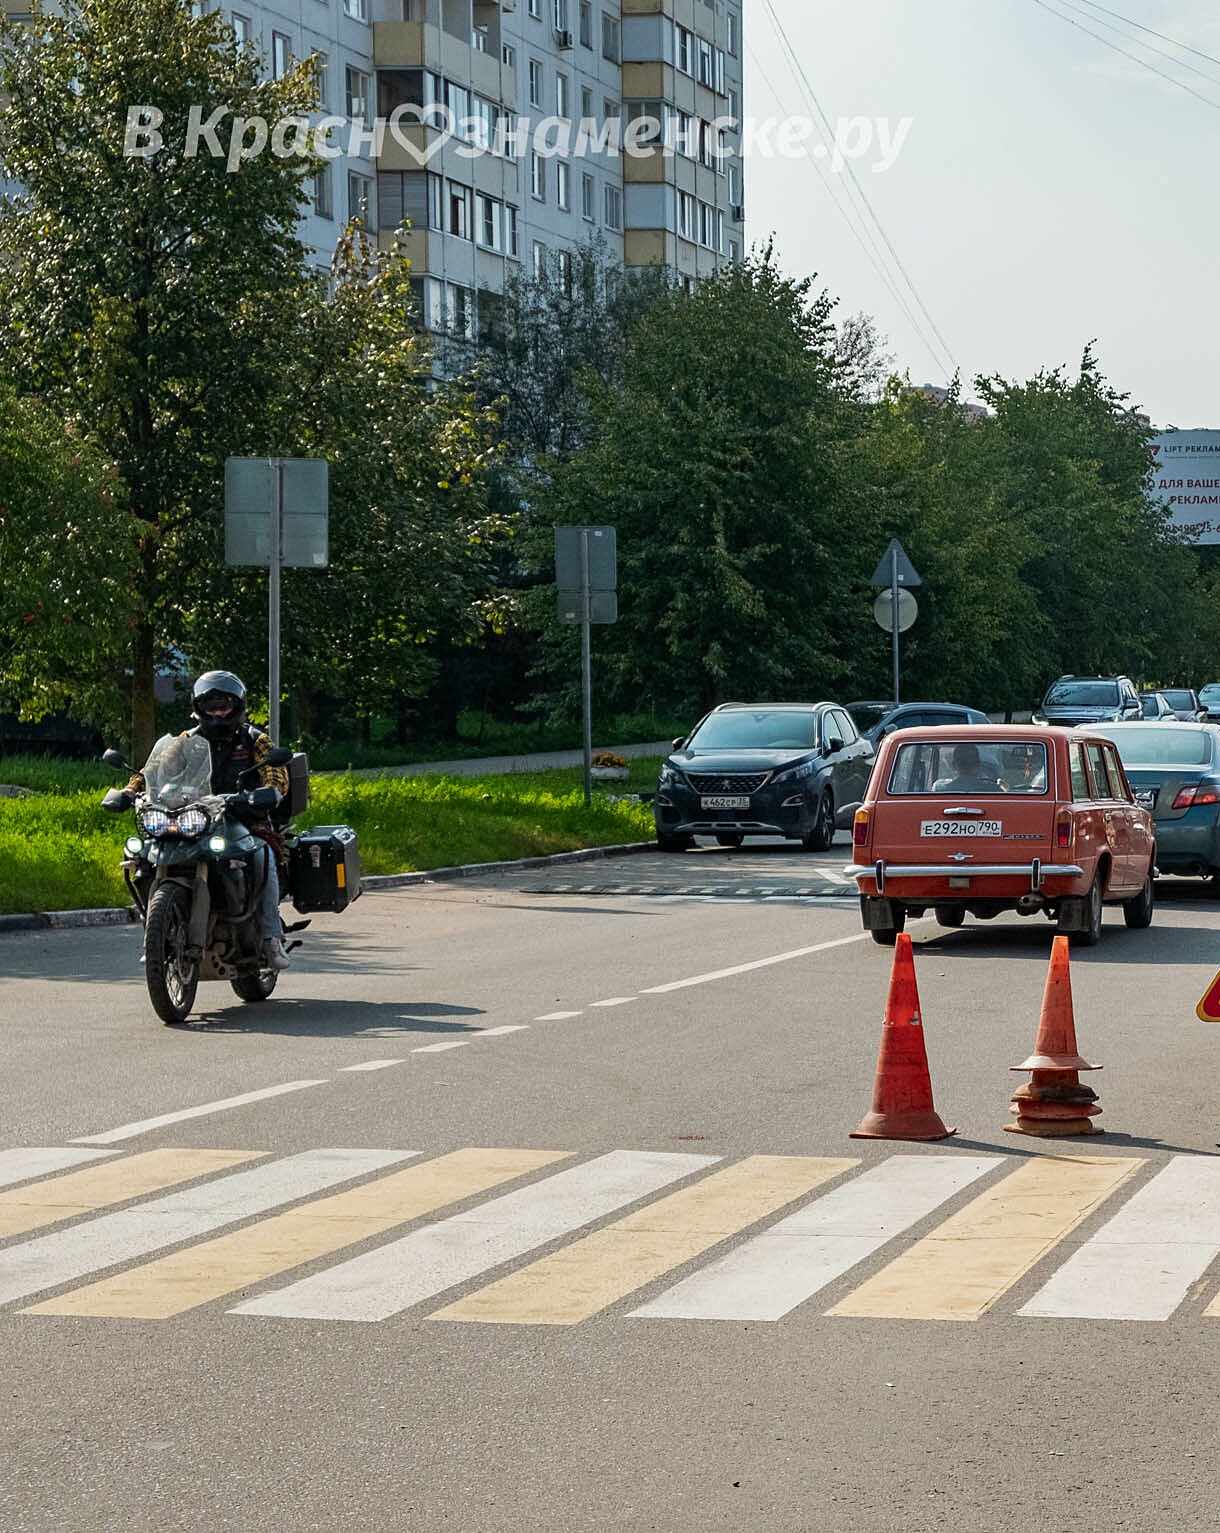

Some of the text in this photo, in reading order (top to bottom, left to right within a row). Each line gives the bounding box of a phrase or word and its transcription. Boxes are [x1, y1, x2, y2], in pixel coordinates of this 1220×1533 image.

[1158, 479, 1183, 489] ДЛЯ
[925, 822, 997, 835] Е292НО 790
